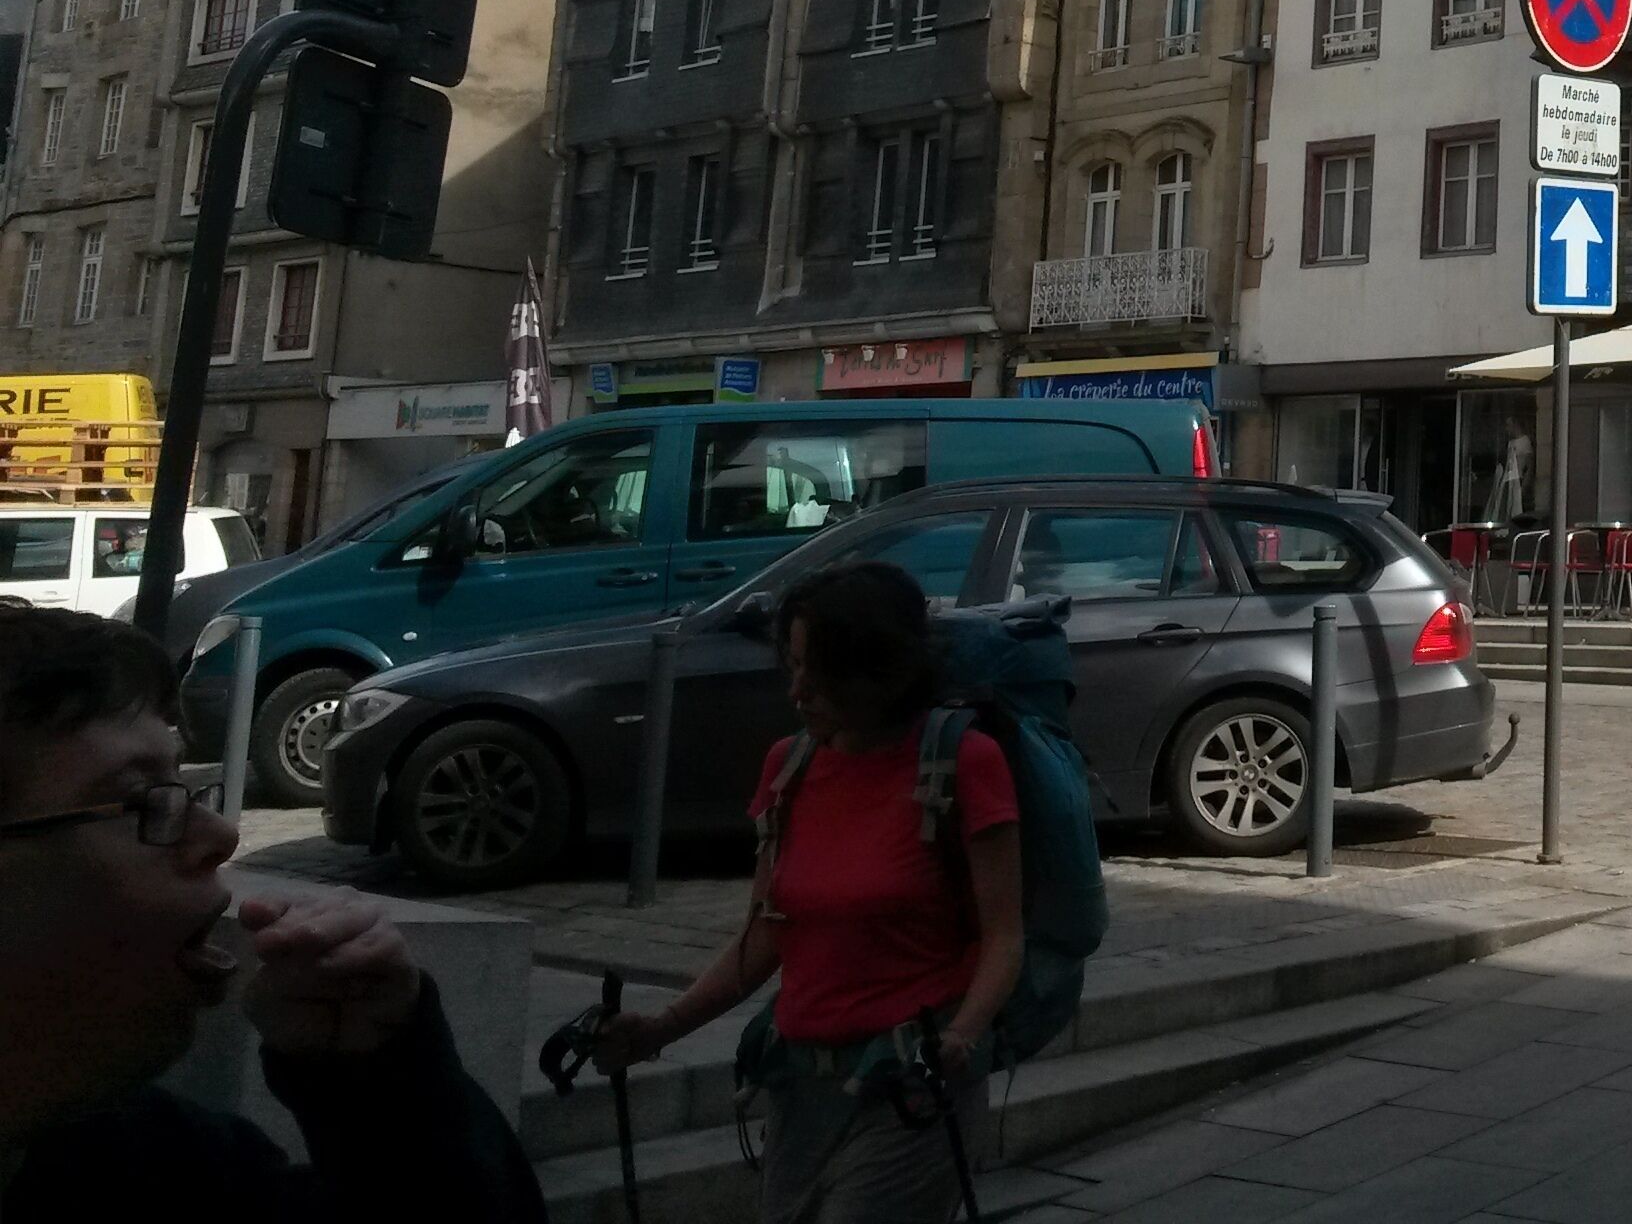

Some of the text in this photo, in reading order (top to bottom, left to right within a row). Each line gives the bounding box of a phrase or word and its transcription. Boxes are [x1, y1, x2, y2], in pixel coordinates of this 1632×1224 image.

[1561, 84, 1600, 104] Marché
[1542, 103, 1617, 127] hebdomadaire
[1561, 124, 1598, 146] le jeudi
[1540, 146, 1618, 168] De 7h00 à 14h00
[1068, 378, 1128, 399] crêperie
[1133, 370, 1152, 398] du
[1156, 370, 1204, 398] centre
